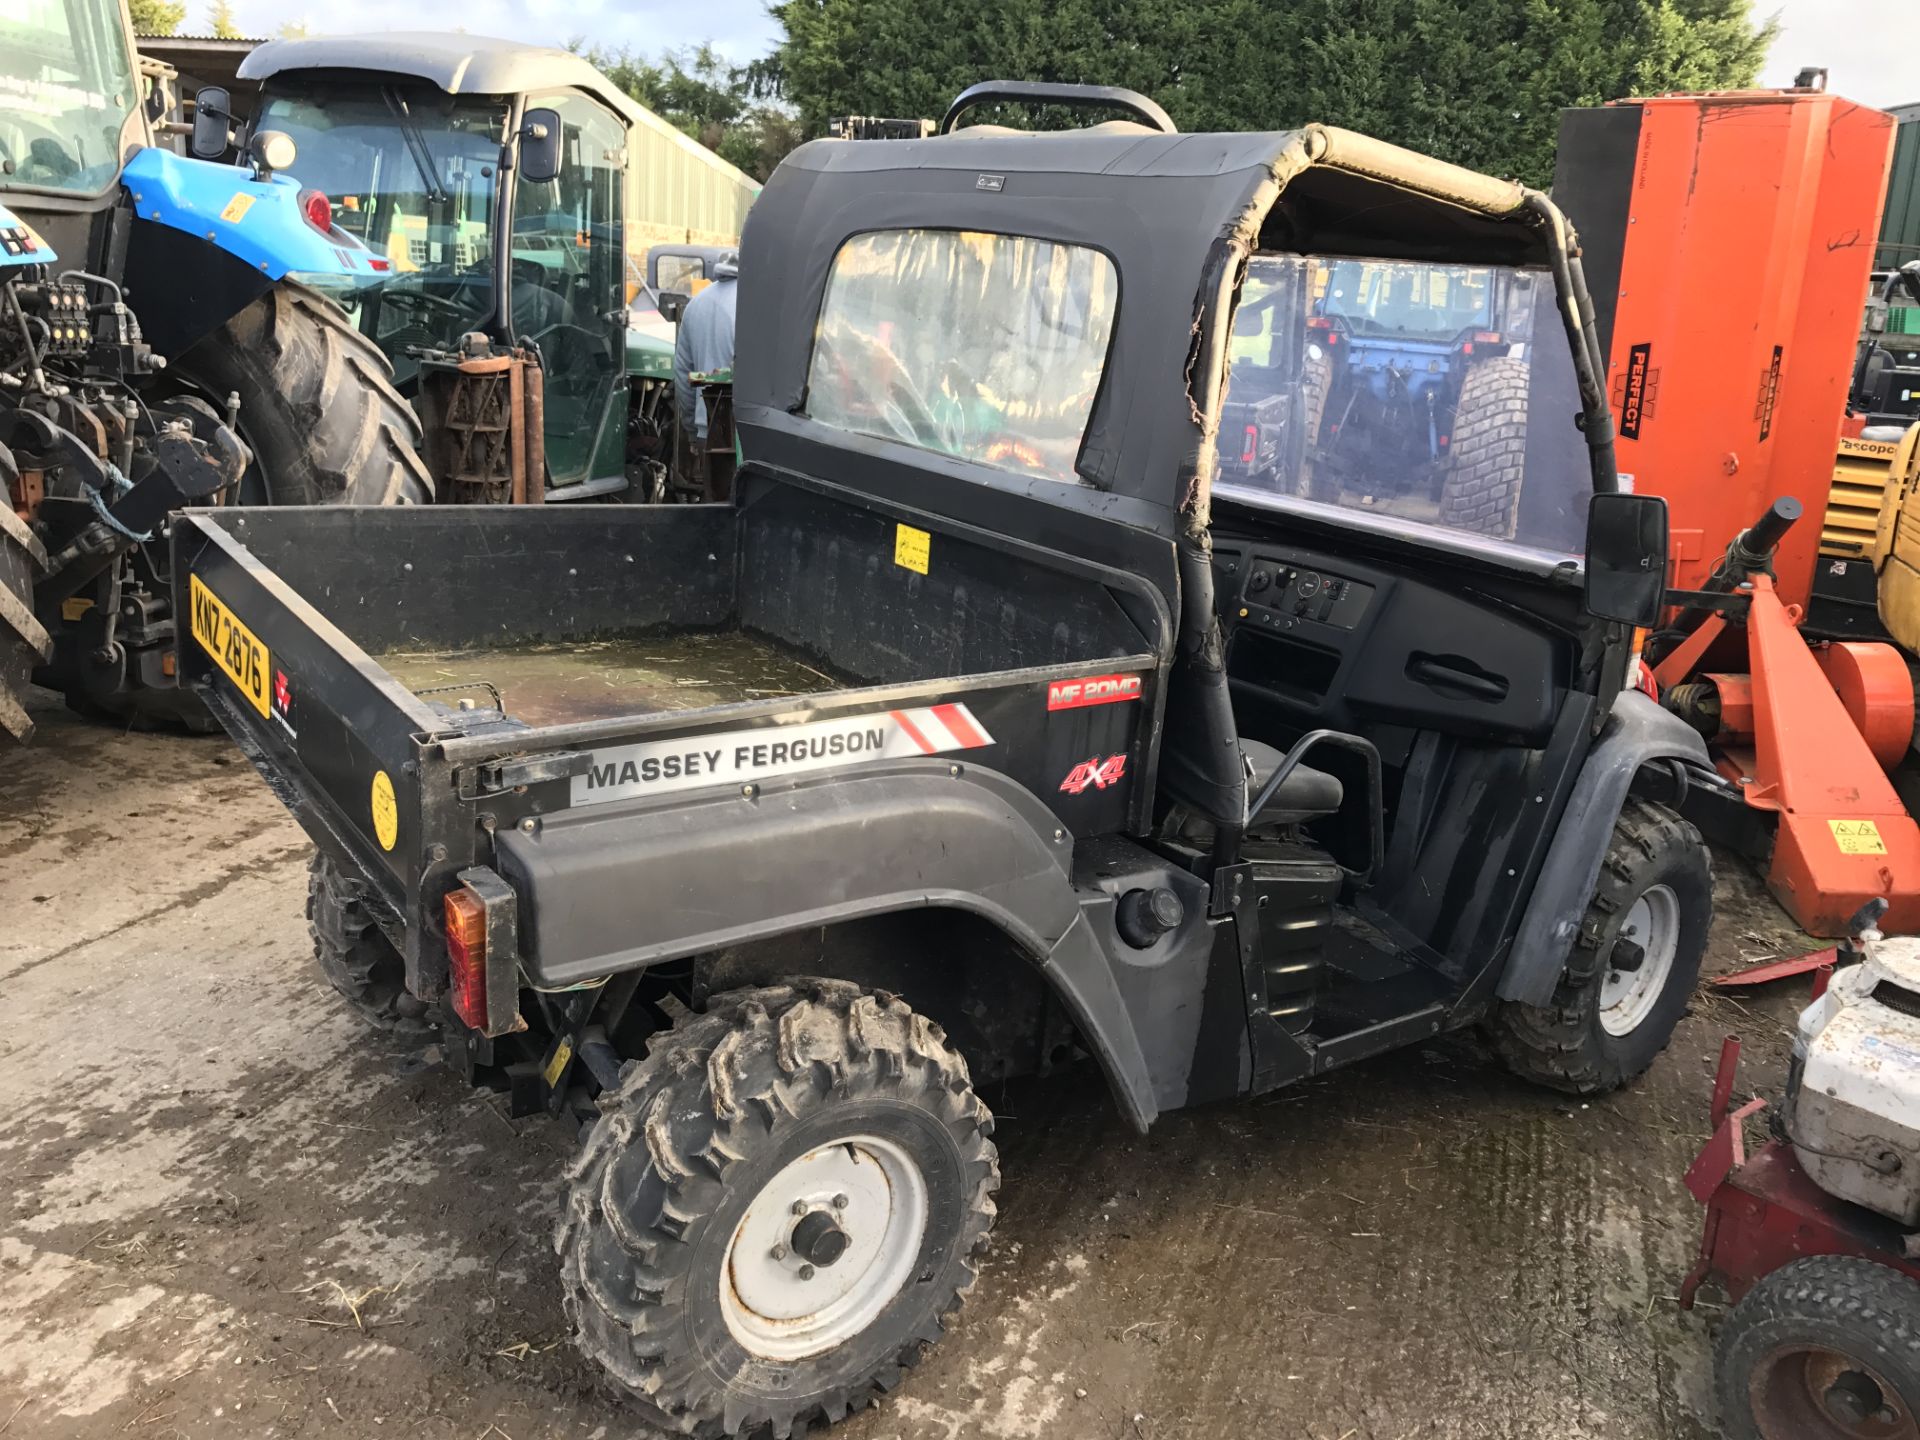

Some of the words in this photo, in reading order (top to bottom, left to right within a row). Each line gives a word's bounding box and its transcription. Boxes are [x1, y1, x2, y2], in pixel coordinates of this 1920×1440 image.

[1625, 351, 1646, 431] PERFECT
[195, 586, 221, 655] KNZ
[224, 616, 262, 699] 2876
[1050, 684, 1082, 705] MF
[587, 749, 721, 790] MASSEY
[734, 728, 884, 769] FERGUSON
